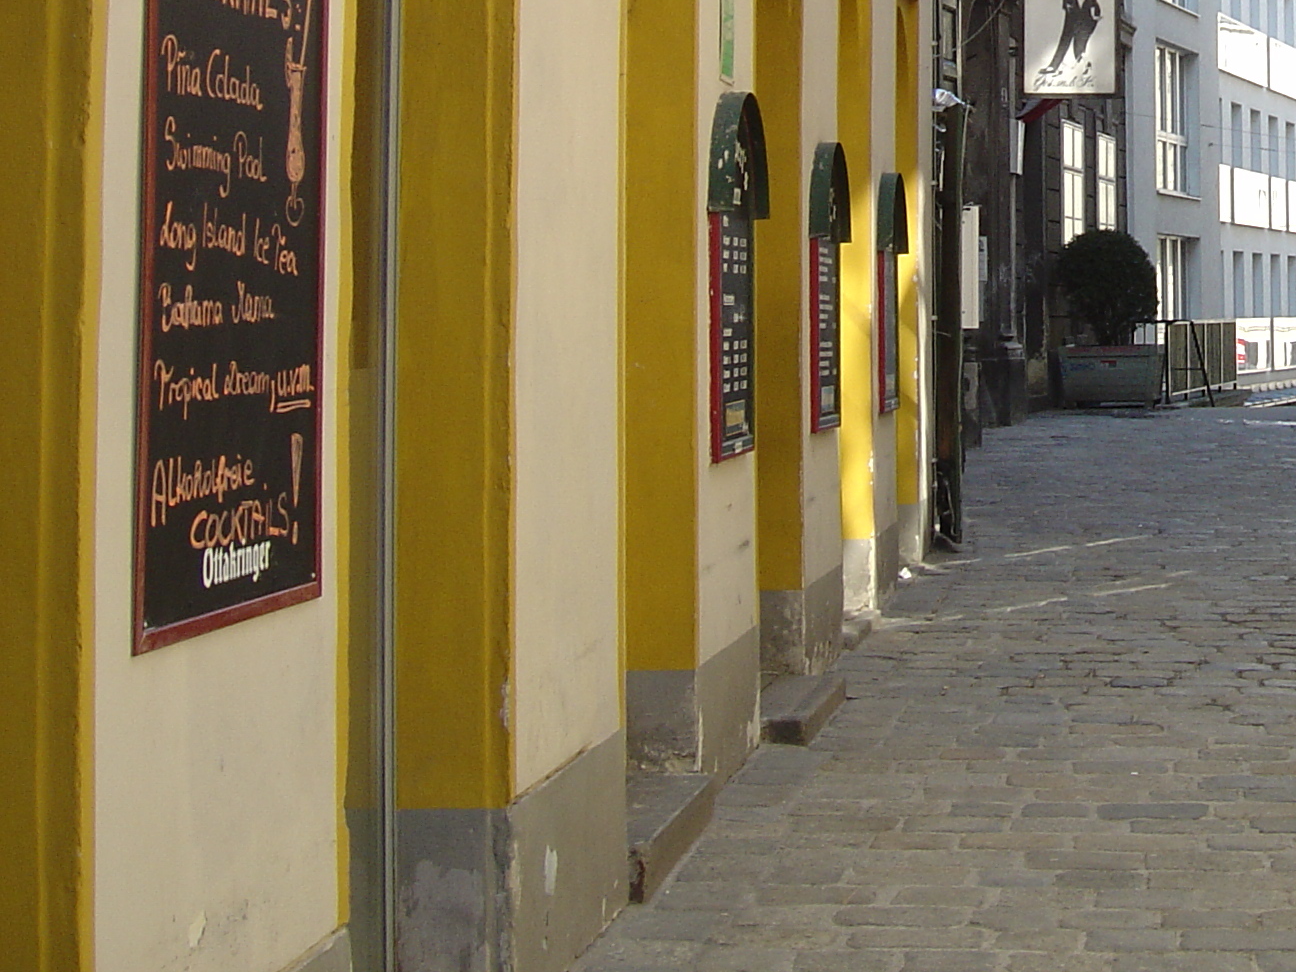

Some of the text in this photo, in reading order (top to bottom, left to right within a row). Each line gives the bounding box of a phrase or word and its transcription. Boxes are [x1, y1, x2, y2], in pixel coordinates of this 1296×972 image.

[206, 48, 264, 111] Colada
[165, 116, 267, 198] Swimming Pool
[159, 200, 298, 277] Long Island Ice Tea
[157, 282, 223, 332] Bahama
[153, 359, 219, 421] Tropical
[203, 539, 271, 588] Ottakringer
